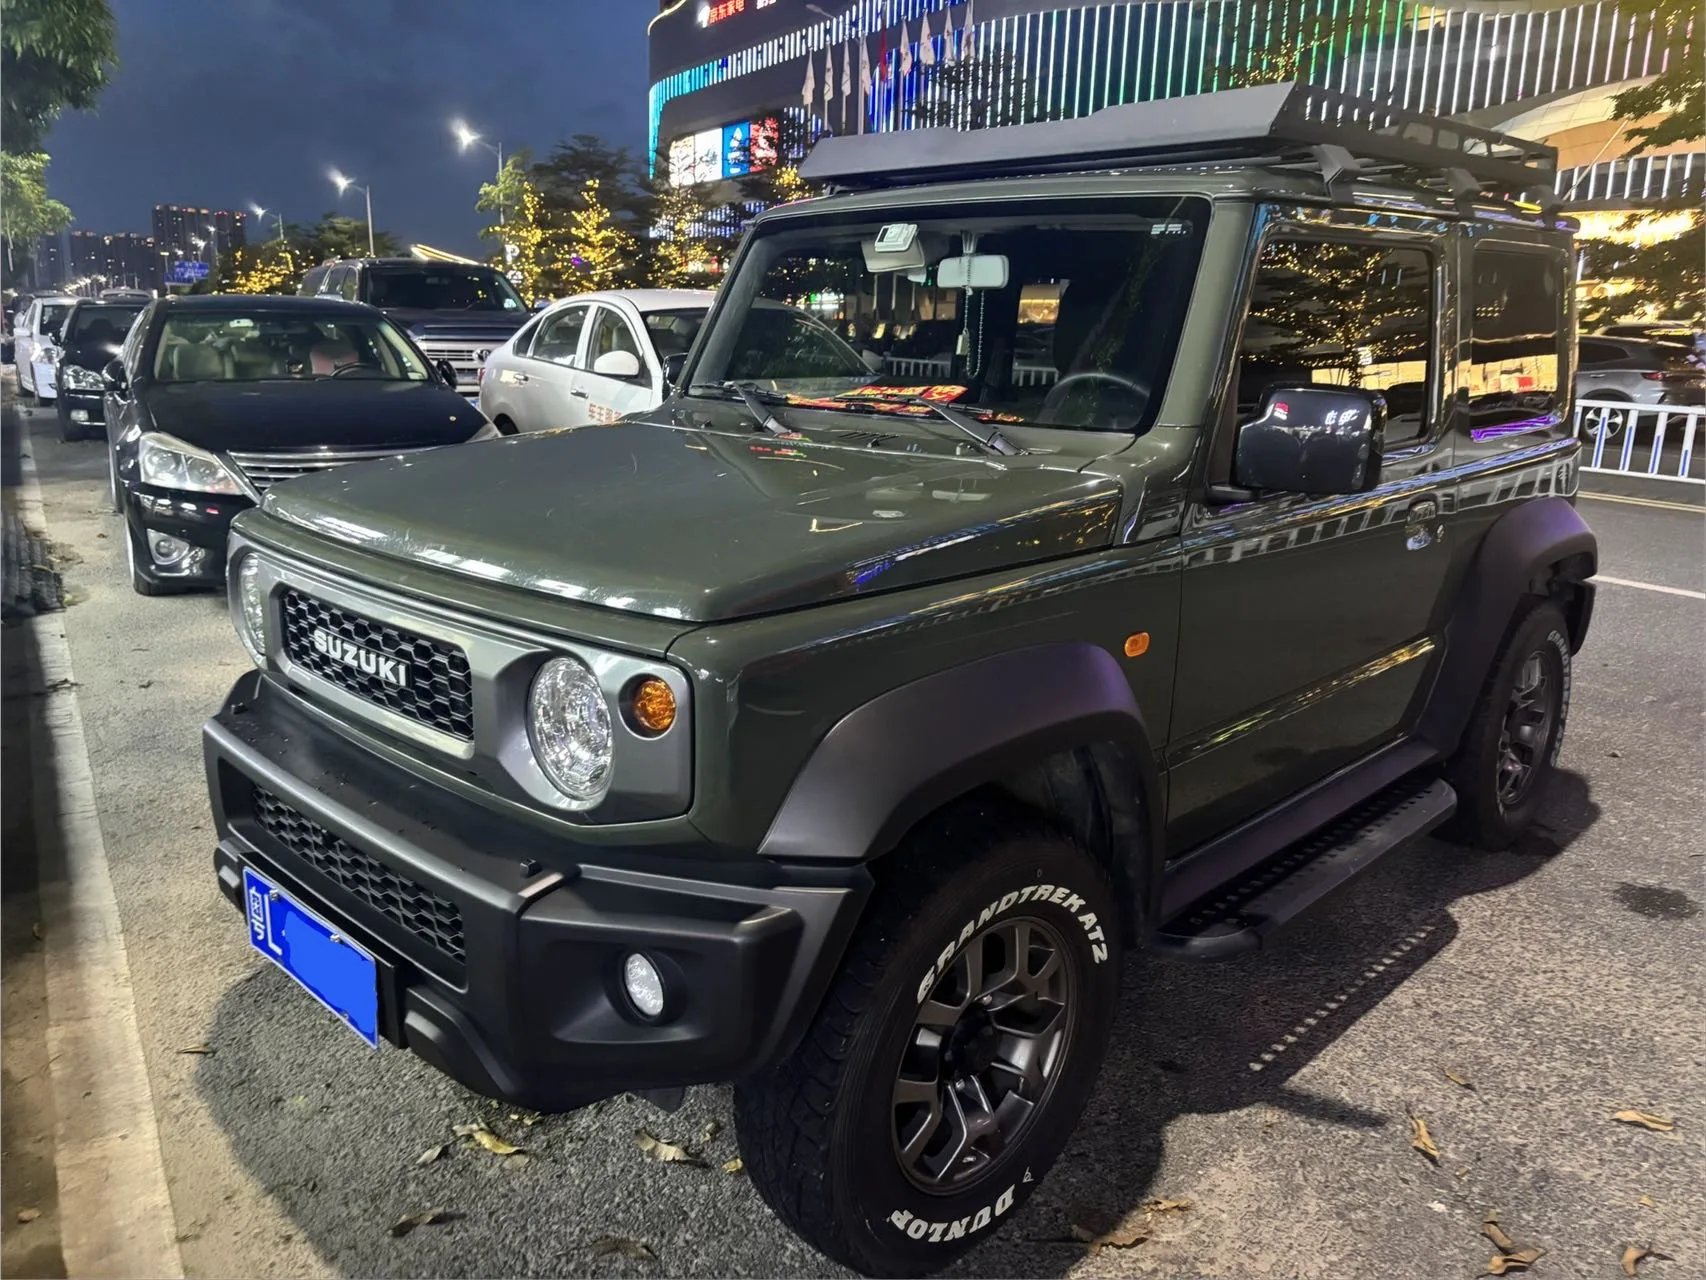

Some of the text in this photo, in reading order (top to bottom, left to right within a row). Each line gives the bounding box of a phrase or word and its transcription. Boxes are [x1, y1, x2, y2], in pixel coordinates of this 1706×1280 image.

[709, 0, 745, 24] 京东家电
[313, 629, 407, 686] SUZUKI
[916, 884, 1109, 1004] GRANDTREK AT2
[891, 1184, 1016, 1243] DUNLOP
